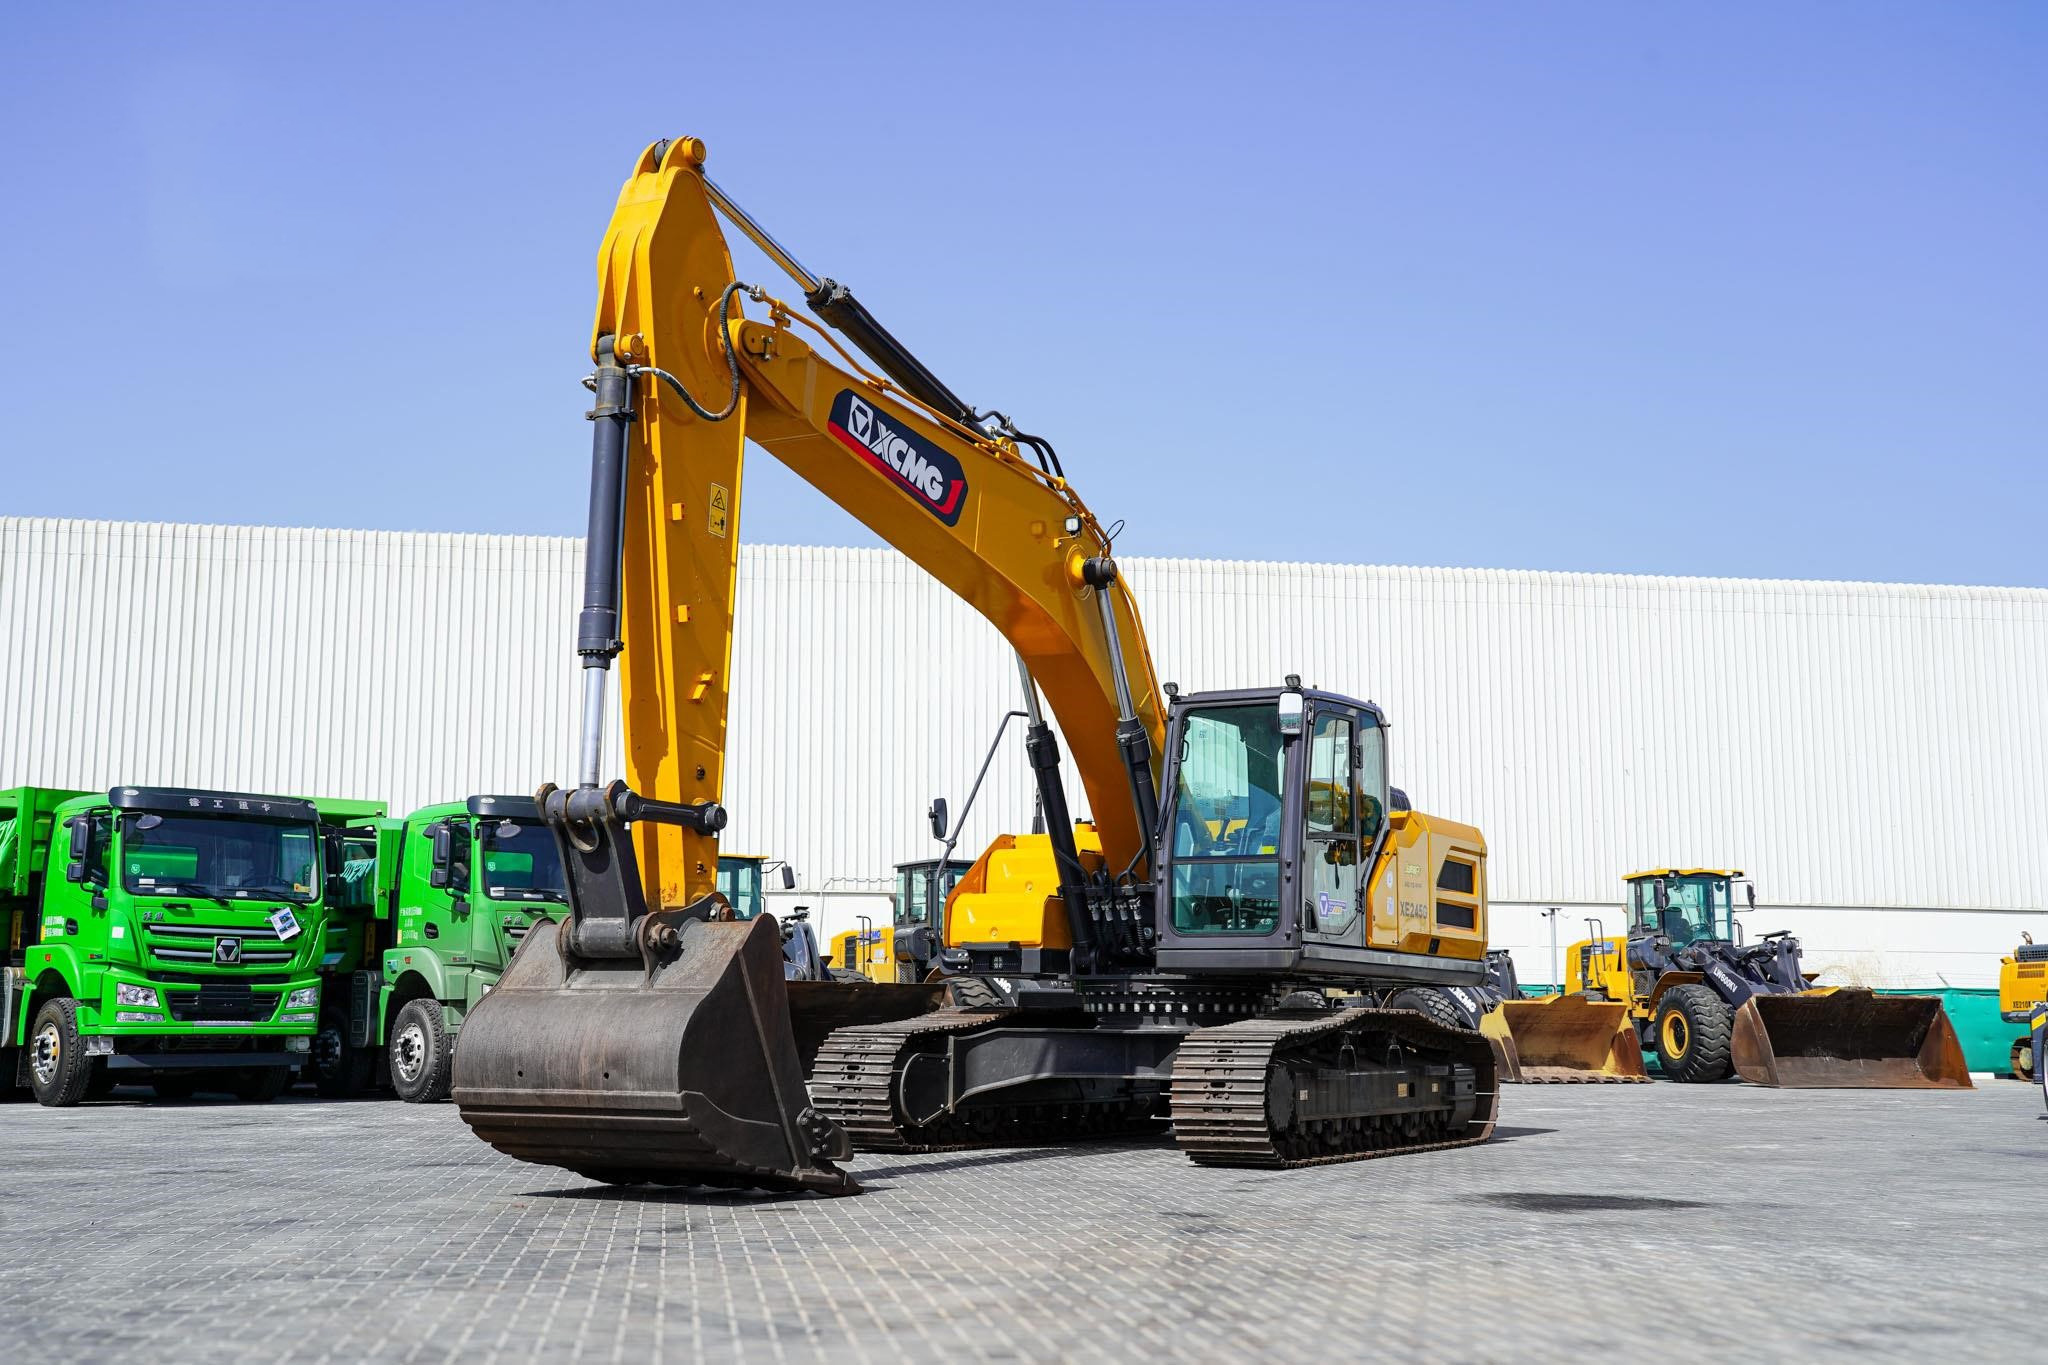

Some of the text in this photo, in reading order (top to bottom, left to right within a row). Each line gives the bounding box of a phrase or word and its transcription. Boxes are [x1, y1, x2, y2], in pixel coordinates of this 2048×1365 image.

[868, 419, 944, 501] XCMG
[1713, 966, 1738, 993] LW600KV
[1452, 986, 1477, 1013] XCMG
